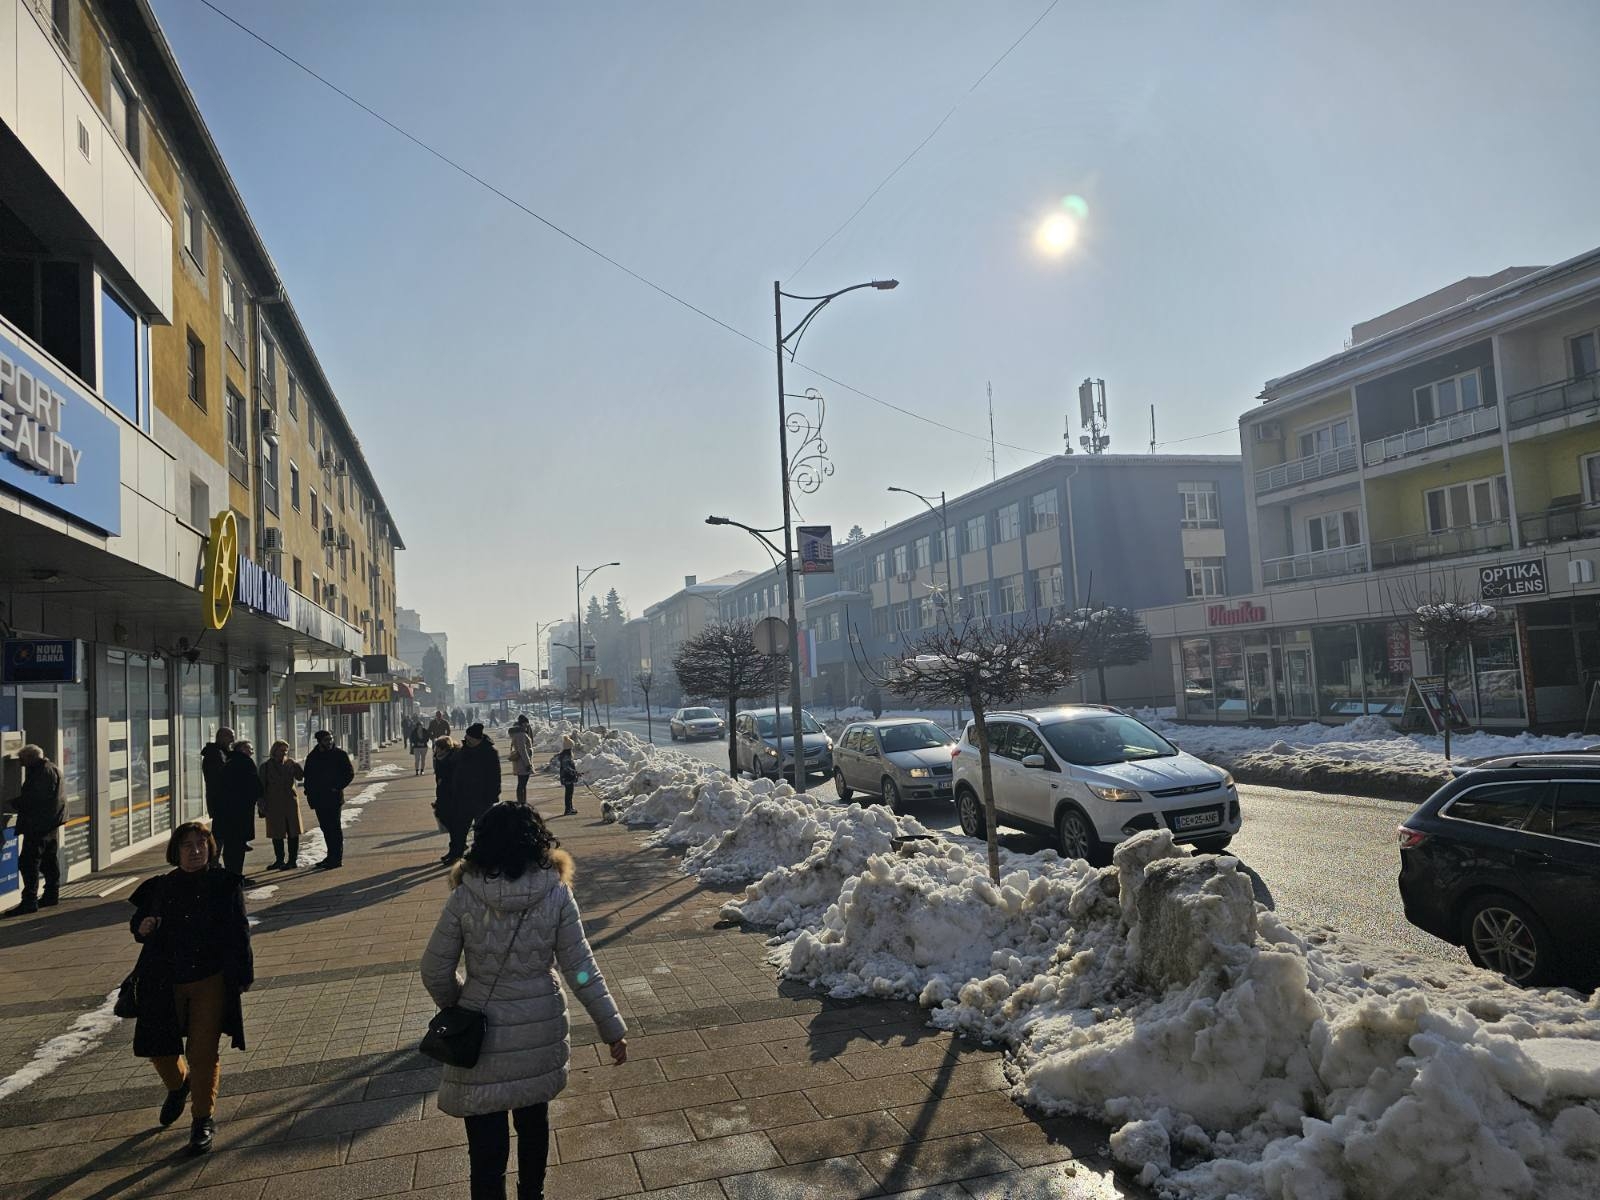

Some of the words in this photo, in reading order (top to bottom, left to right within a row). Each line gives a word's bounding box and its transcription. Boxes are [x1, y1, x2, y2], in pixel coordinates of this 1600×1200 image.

[1482, 563, 1541, 582] OPTIKA
[239, 554, 263, 611] NOVA
[266, 571, 288, 621] BANKA
[1508, 579, 1543, 594] LENS
[36, 644, 63, 654] NOVA
[36, 654, 64, 662] BANKA
[324, 688, 388, 702] ZLATARA
